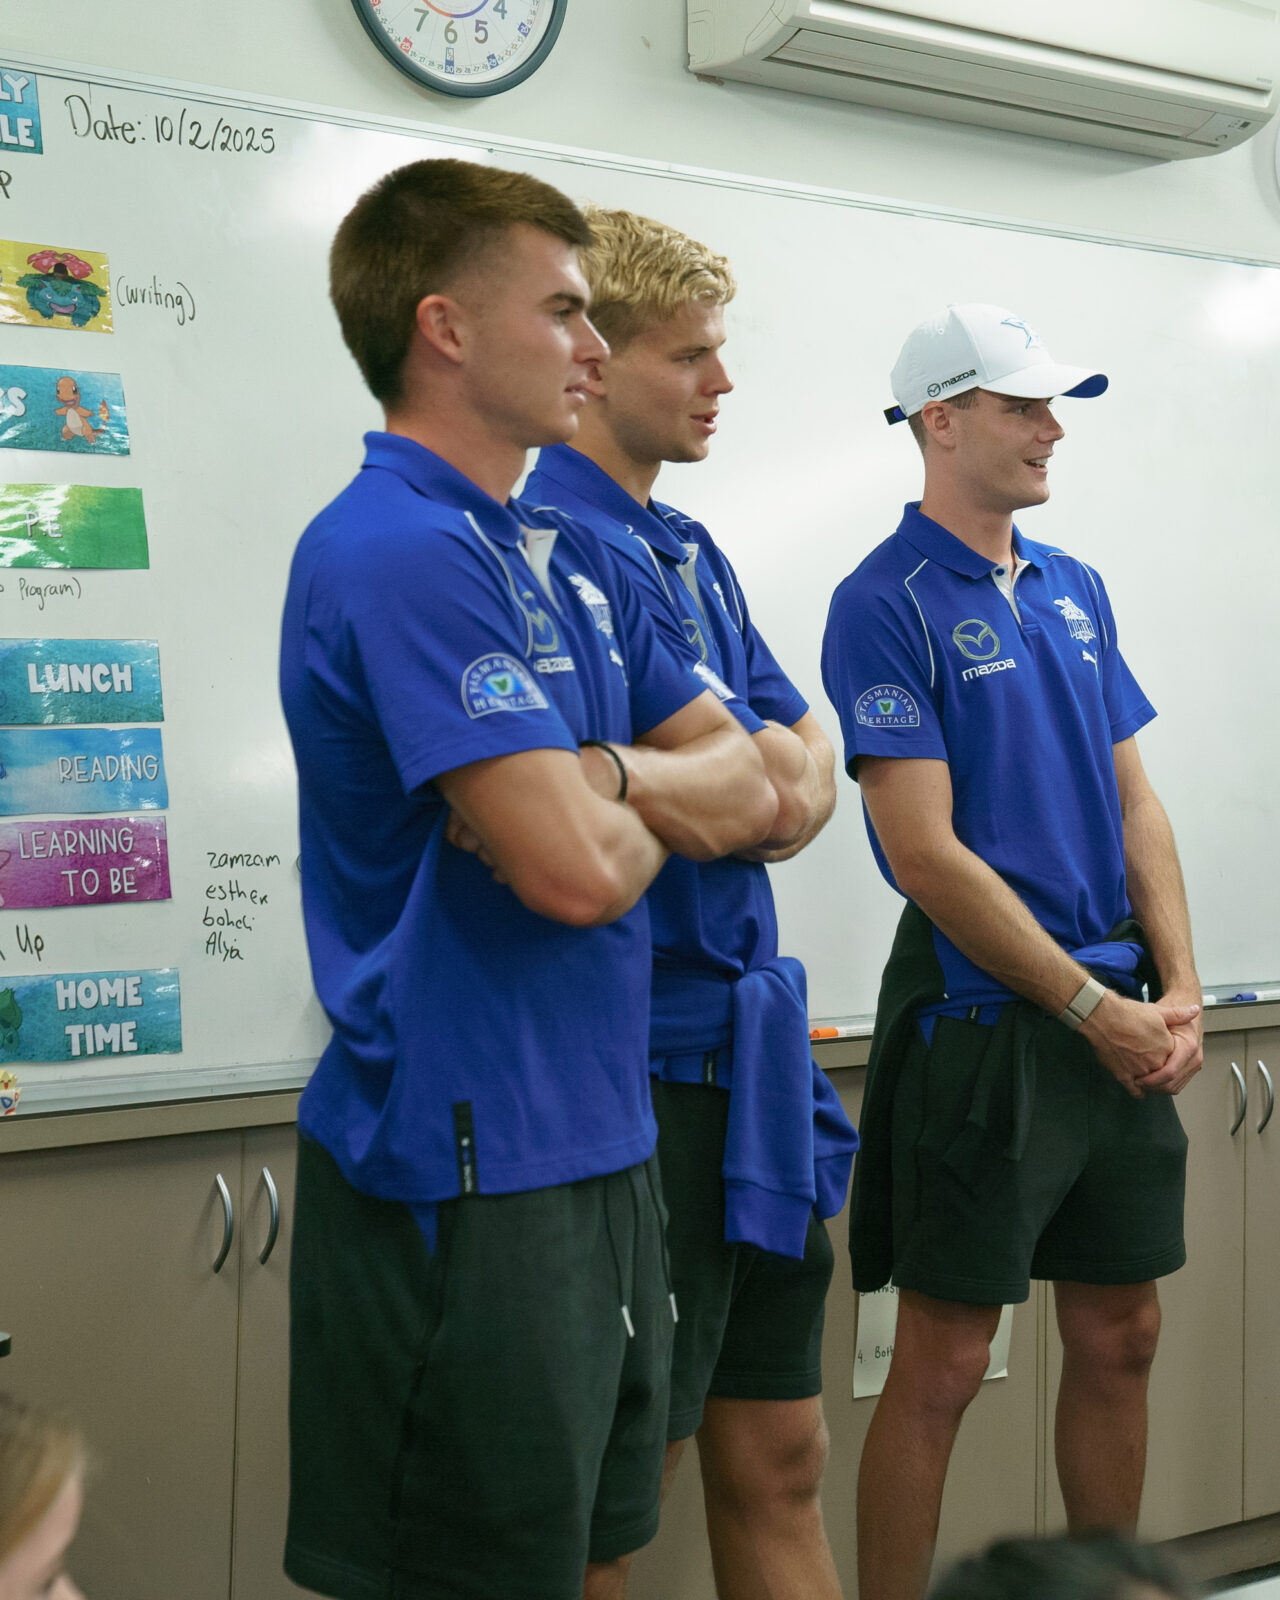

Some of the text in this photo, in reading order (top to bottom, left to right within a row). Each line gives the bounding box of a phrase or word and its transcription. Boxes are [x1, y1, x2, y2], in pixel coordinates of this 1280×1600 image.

[413, 8, 430, 33] 7
[444, 20, 458, 44] 6
[474, 19, 489, 44] 5
[64, 94, 276, 154] Date: 10/2/2025
[116, 275, 196, 326] (writing)
[941, 368, 977, 389] mazda
[27, 662, 133, 694] LUNCH
[962, 658, 1017, 682] mazda
[860, 688, 913, 712] TASMANIAN
[860, 714, 917, 724] HERITAGE
[58, 755, 160, 784] READING
[19, 827, 135, 860] LEARNING
[61, 866, 138, 896] TO BE
[16, 924, 45, 962] Up
[55, 976, 143, 1011] HOME
[65, 1021, 138, 1056] TIME
